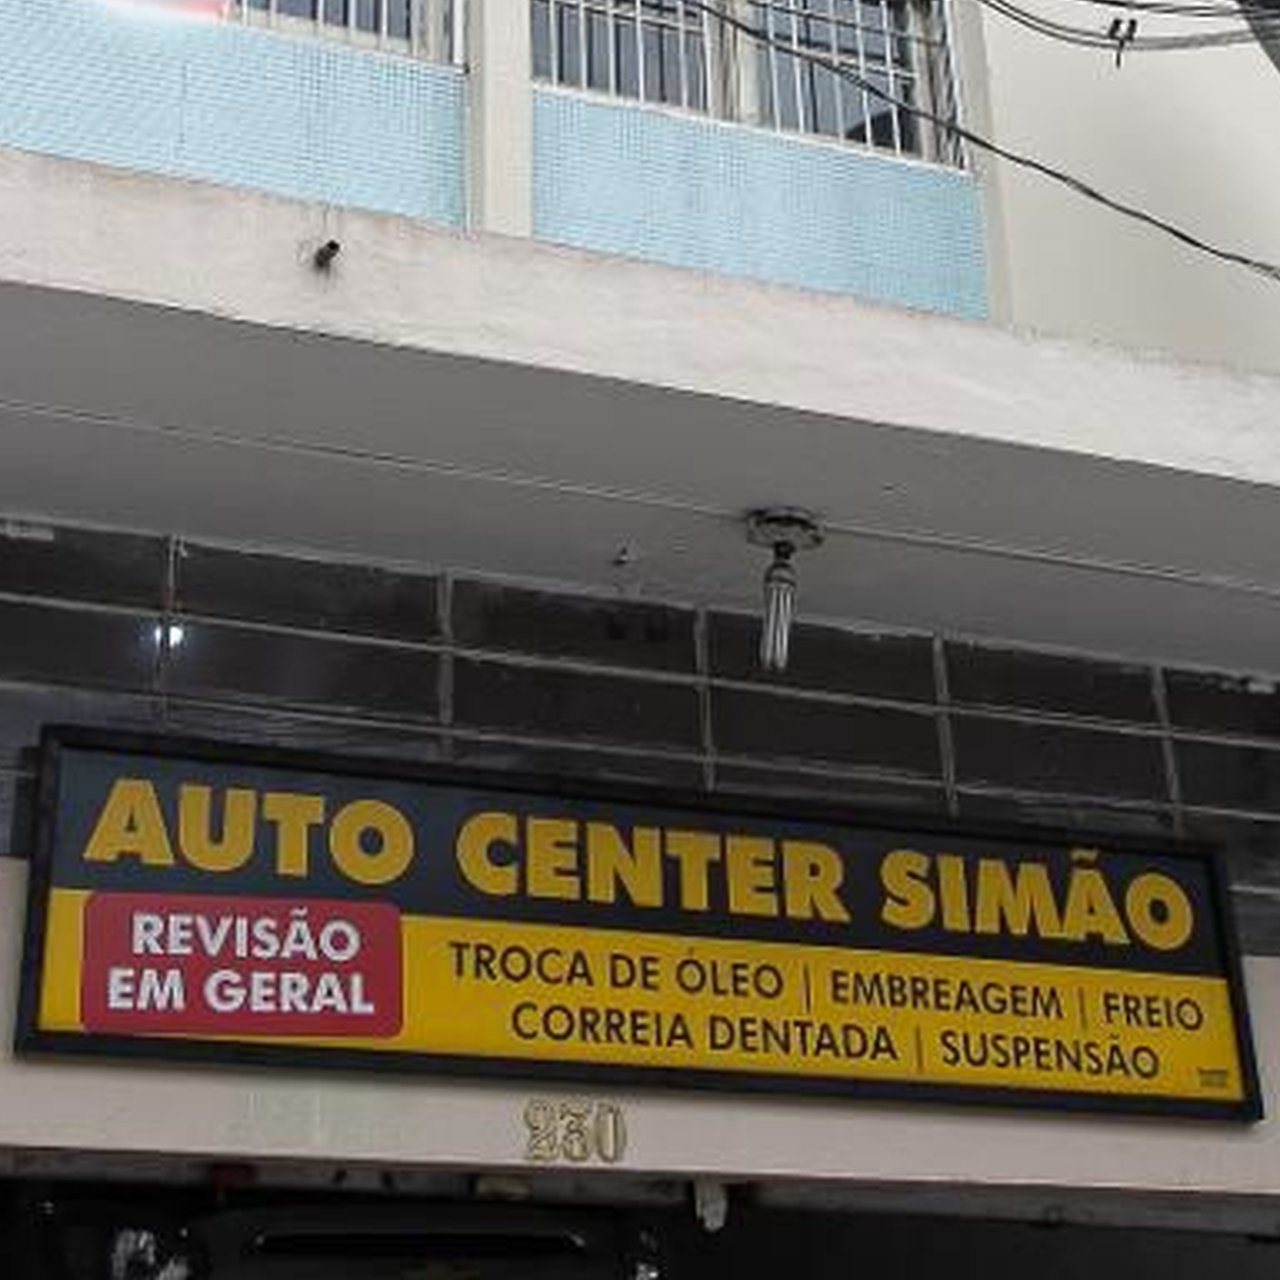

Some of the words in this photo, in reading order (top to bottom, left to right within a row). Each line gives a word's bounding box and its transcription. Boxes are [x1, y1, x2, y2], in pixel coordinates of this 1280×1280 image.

[82, 778, 416, 885] AUTO
[455, 811, 851, 923] CENTER
[879, 846, 1194, 952] SIMÃO
[131, 907, 363, 962] REVISÃO
[107, 967, 186, 1011] EM
[204, 969, 375, 1015] GERAL
[448, 941, 594, 987] TROCA
[609, 953, 660, 991] DE
[675, 947, 784, 1000] ÓLEO
[830, 970, 1064, 1020] EMBREAGEM
[1103, 992, 1205, 1032] FREIO
[511, 1002, 694, 1051] CORREIA
[708, 1017, 898, 1062] DENTADA
[939, 1032, 1160, 1080] SUSPENSÃO
